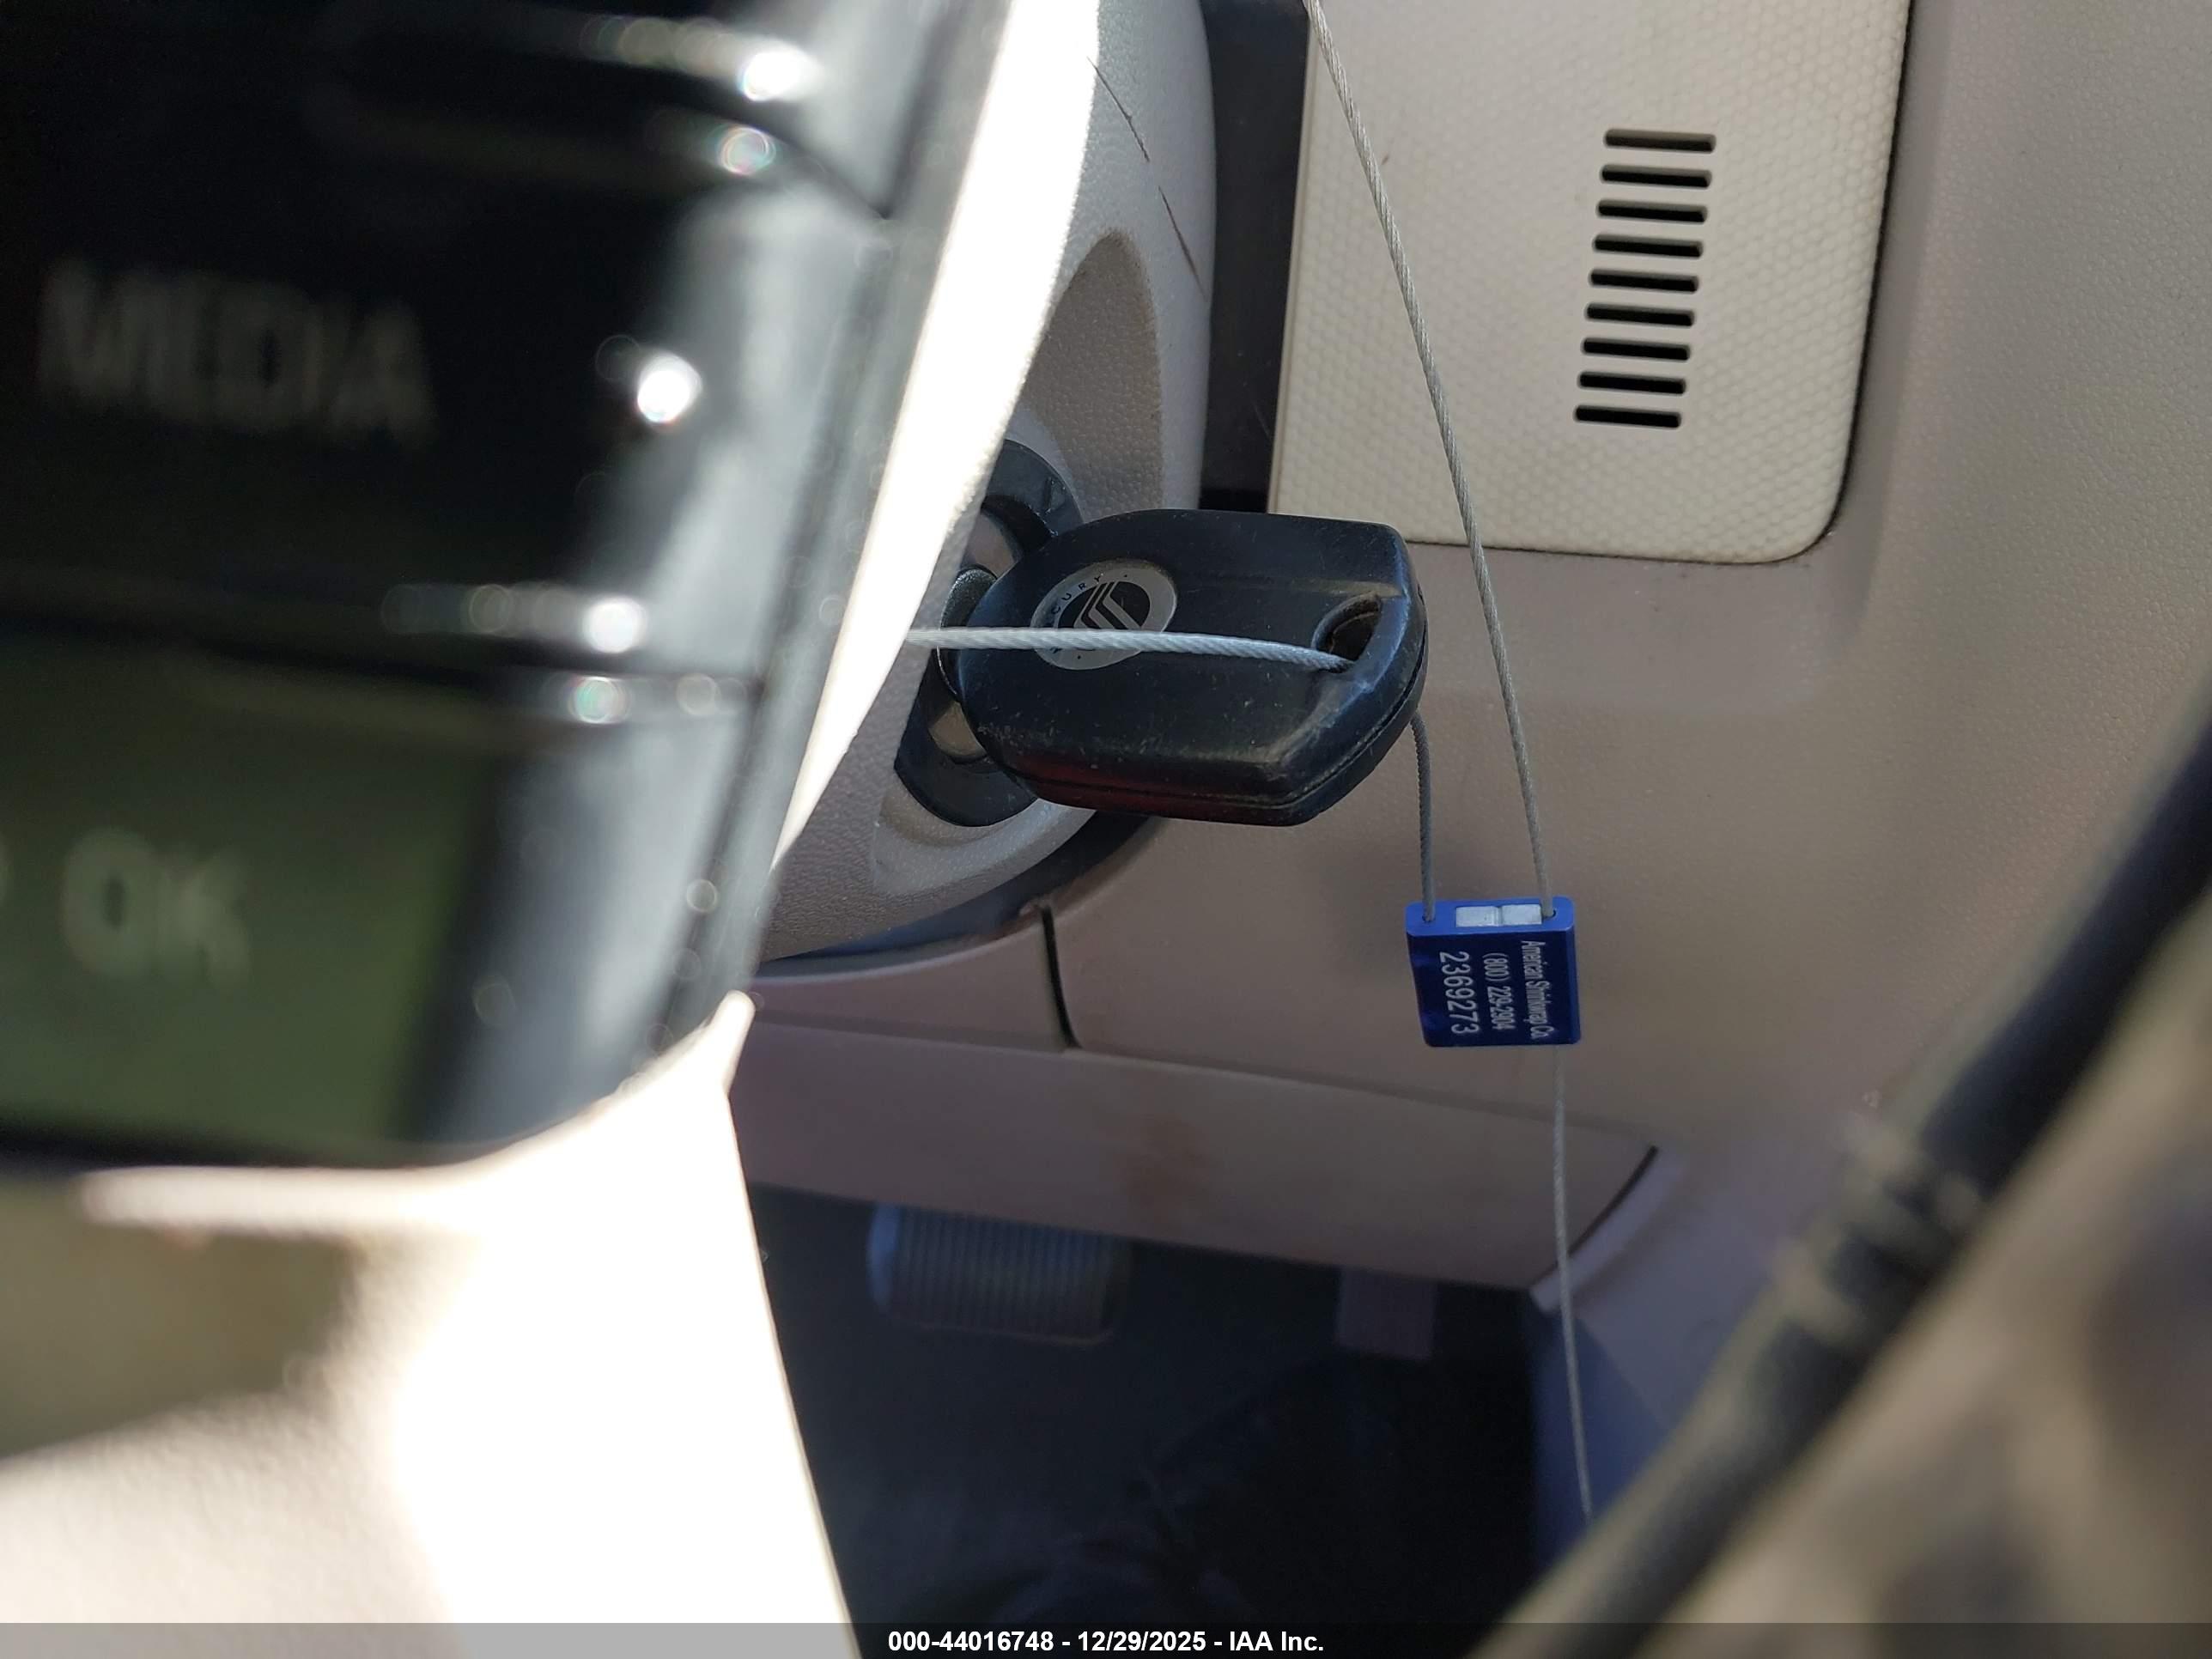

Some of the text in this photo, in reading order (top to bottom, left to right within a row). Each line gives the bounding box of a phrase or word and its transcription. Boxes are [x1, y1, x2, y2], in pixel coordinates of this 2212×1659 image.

[41, 258, 436, 448] MEDIA
[60, 826, 251, 985] OK
[1439, 951, 1480, 1034] 2369273
[1482, 952, 1516, 1030] (800) 229-2904
[1521, 940, 1548, 980] American
[1523, 981, 1553, 1024] Shrinkwrap
